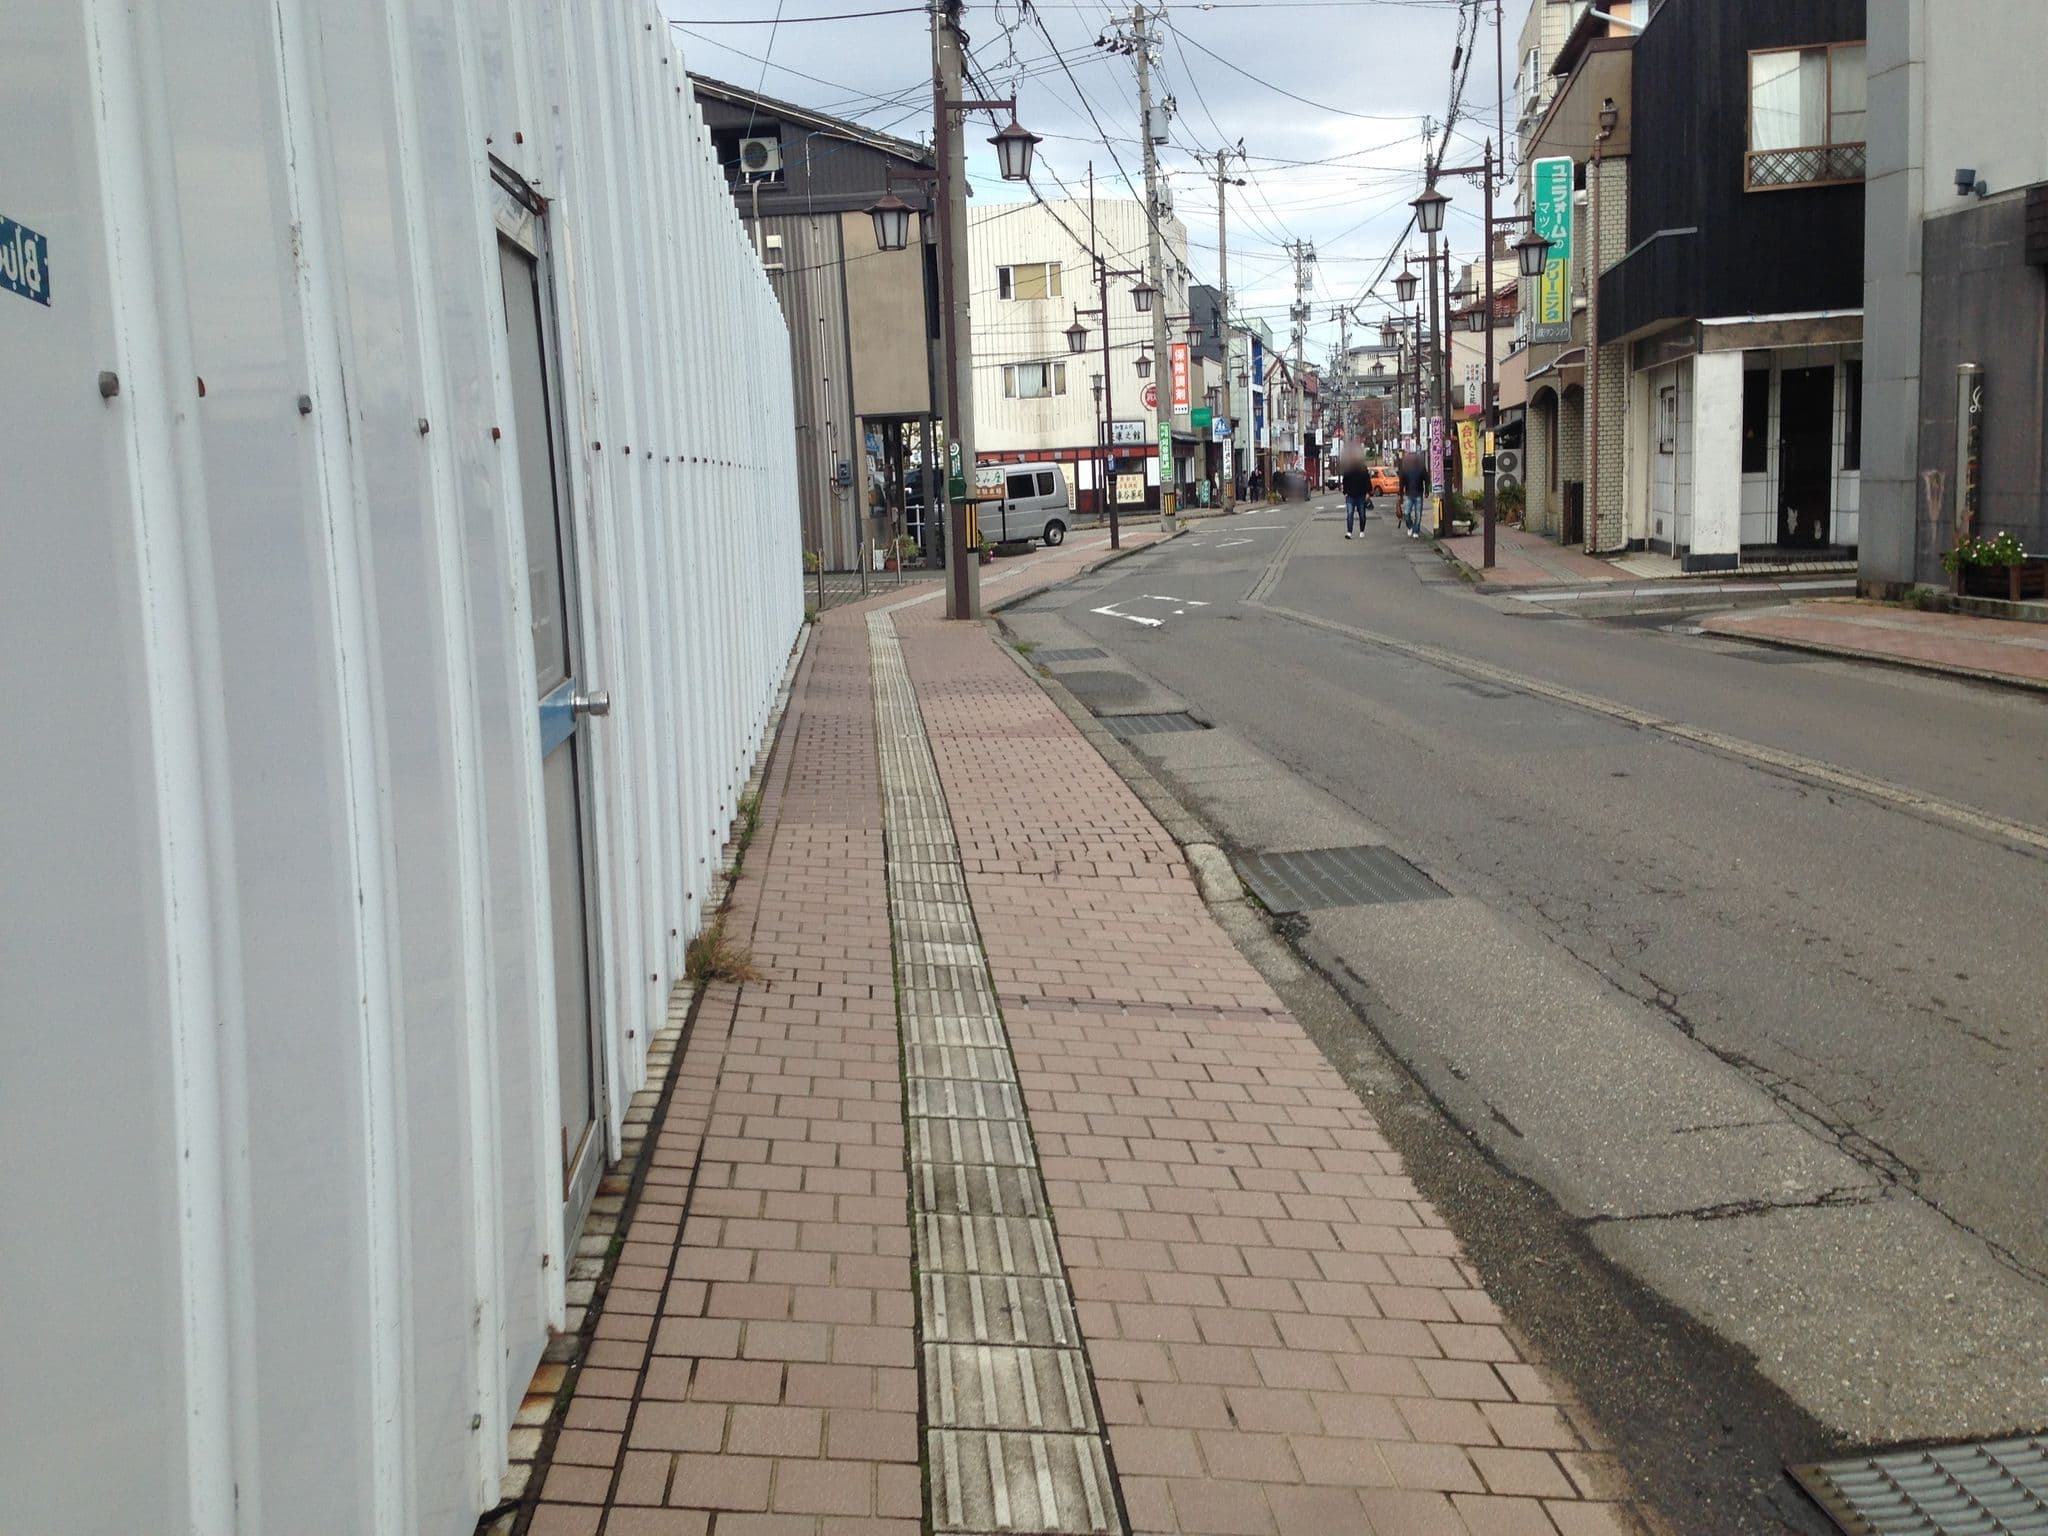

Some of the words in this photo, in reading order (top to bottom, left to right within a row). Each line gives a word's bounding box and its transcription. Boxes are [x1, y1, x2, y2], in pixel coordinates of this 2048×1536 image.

[1538, 202, 1550, 242] マツシ
[1551, 164, 1567, 248] ユニフォームの
[1545, 261, 1560, 320] クリーニング
